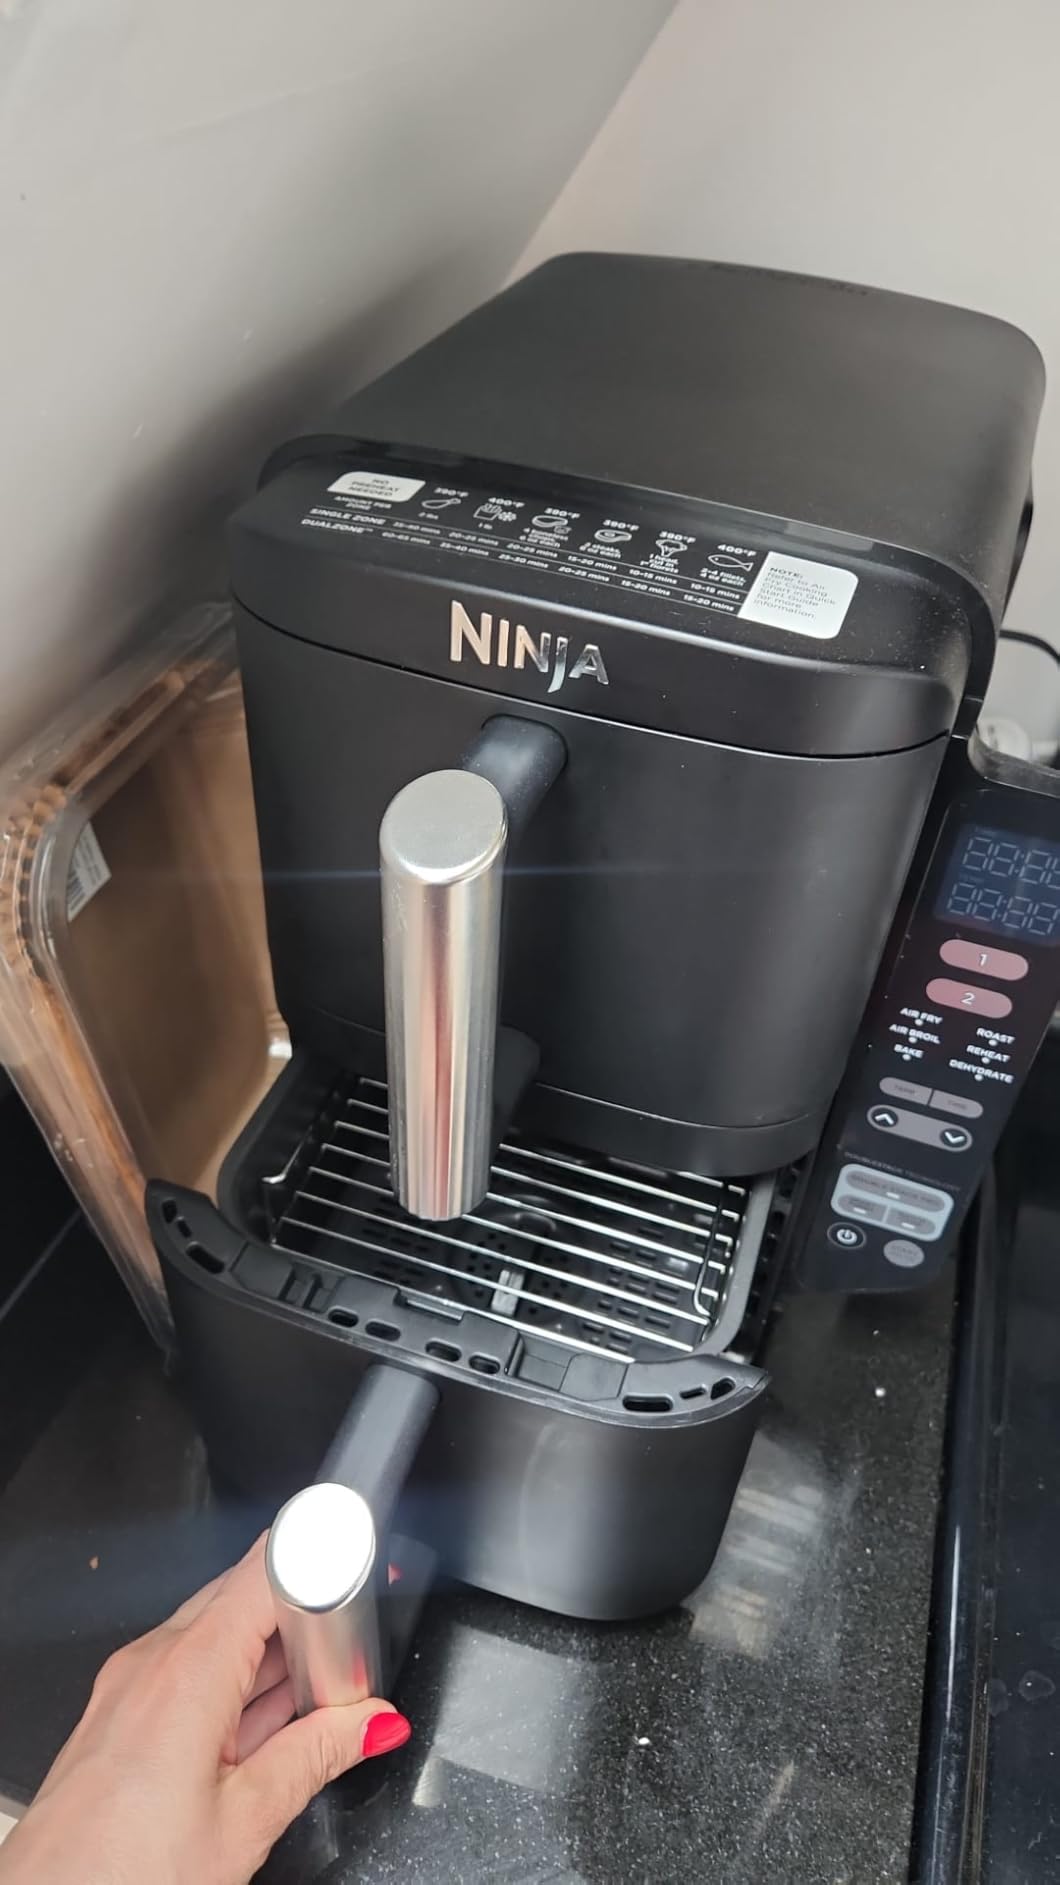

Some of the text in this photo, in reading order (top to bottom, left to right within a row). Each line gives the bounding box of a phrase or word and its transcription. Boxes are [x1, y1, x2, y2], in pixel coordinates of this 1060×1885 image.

[309, 508, 387, 525] SINGLE ZONE
[420, 527, 441, 535] mins
[410, 537, 431, 545] mins
[478, 538, 499, 546] mins
[659, 531, 696, 543] 390°F
[468, 547, 489, 556] mins
[536, 549, 558, 558] mins
[717, 544, 757, 556] 400°F
[526, 560, 549, 568] mins
[594, 560, 617, 571] mins
[587, 572, 610, 582] mins
[770, 567, 803, 579] NOTE:
[654, 575, 677, 584] mins
[648, 586, 670, 596] mins
[760, 588, 784, 598] Start
[762, 583, 790, 593] Chart
[716, 589, 740, 600] mins
[711, 601, 735, 611] mins
[757, 594, 801, 608] for more
[450, 600, 609, 693] NINJA
[979, 953, 988, 966] 1
[961, 992, 975, 1005] 2
[899, 1007, 943, 1025] AIR FRY
[889, 1023, 941, 1045] AIR BROIL
[976, 1027, 1015, 1045] ROAST
[893, 1044, 924, 1059] BAKE
[966, 1044, 1011, 1063] REHEAT
[949, 1059, 1014, 1084] DEHYDRATE
